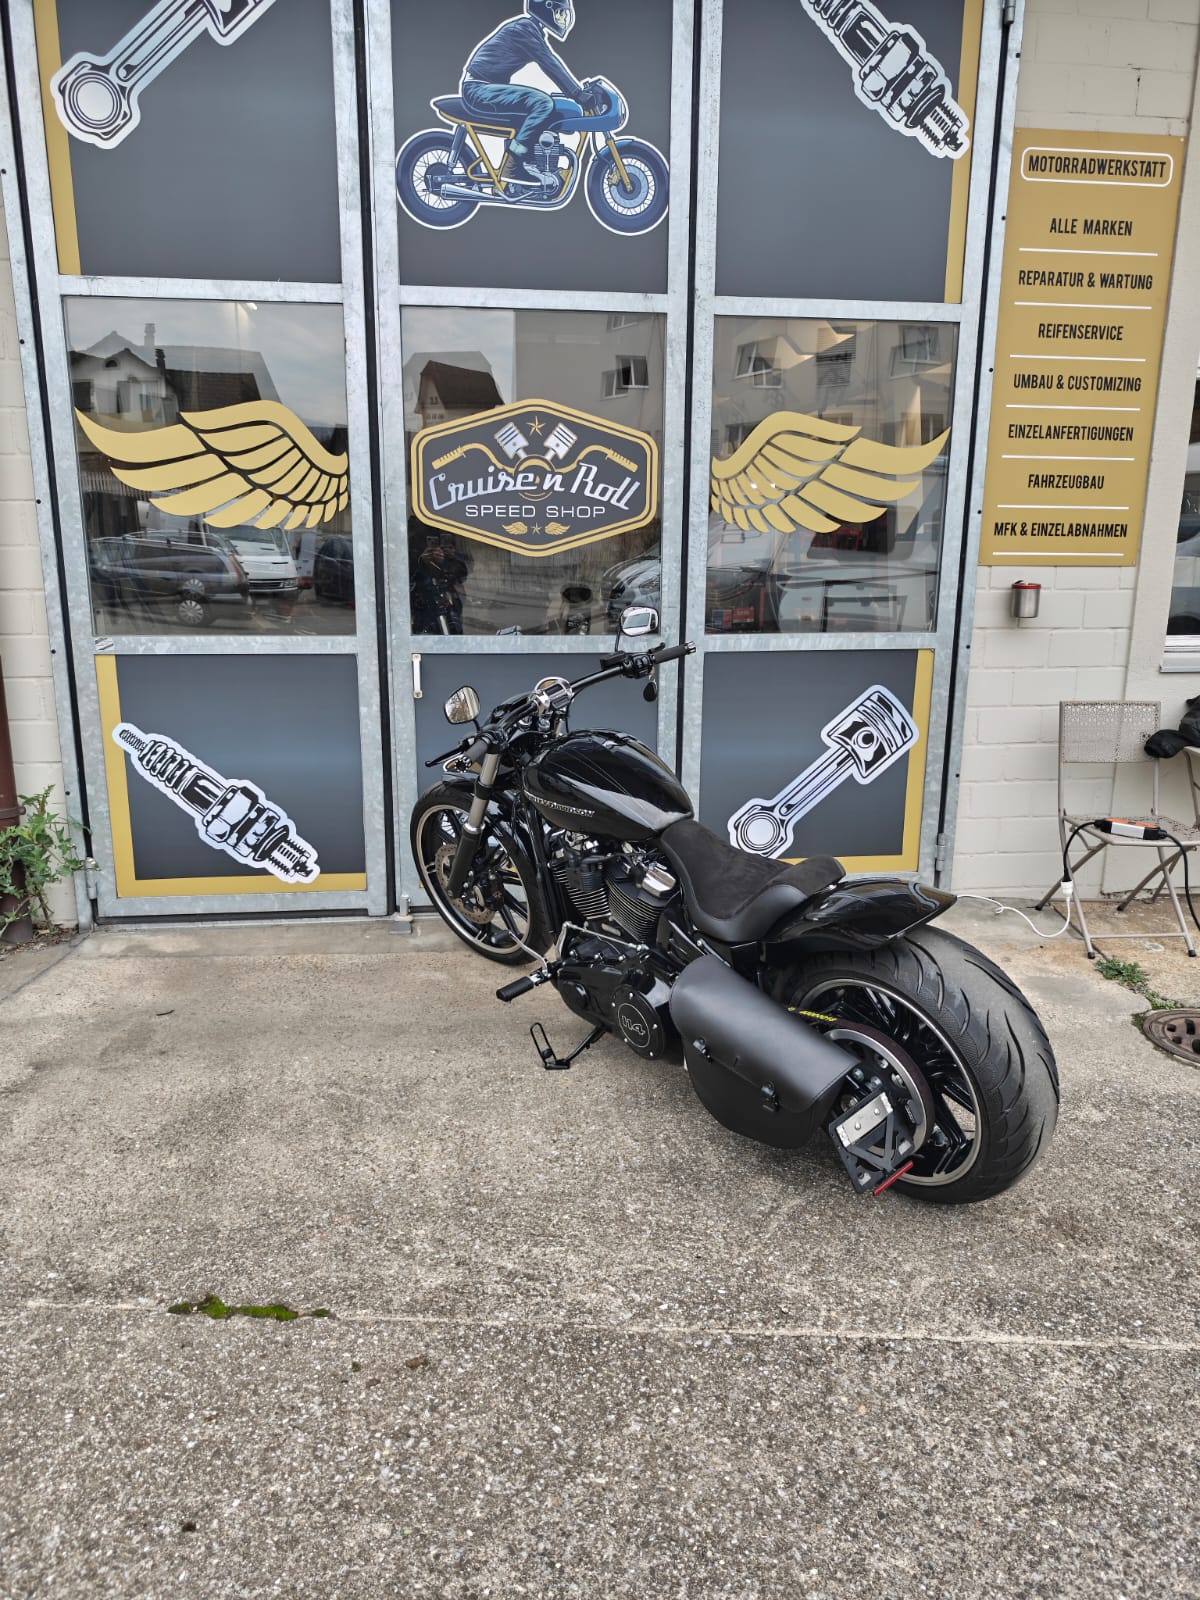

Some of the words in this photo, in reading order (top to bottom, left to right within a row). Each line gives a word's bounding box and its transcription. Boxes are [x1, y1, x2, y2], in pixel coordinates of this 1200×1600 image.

[1028, 155, 1167, 178] MOTORRADWERKSTATT
[1050, 218, 1078, 234] ALLE
[1083, 219, 1133, 236] MARKEN
[1018, 270, 1085, 288] REPARATUR
[1087, 272, 1095, 288] &
[1100, 273, 1153, 290] WARTUNG
[1038, 323, 1124, 341] REIFENSERVICE
[1013, 374, 1054, 389] UMBAU
[1056, 375, 1064, 390] &
[1067, 376, 1142, 392] CUSTOMIZING
[1008, 424, 1134, 441] EINZELANFERTIGUNGEN
[429, 465, 538, 511] Cruise
[542, 467, 565, 491] n
[570, 462, 641, 511] Roll
[1028, 474, 1105, 490] FAHRZEUGBAU
[465, 504, 536, 518] SPEED
[546, 505, 606, 518] SHOP
[993, 522, 1017, 537] MFK
[1020, 522, 1028, 537] &
[1030, 523, 1128, 538] EINZELABNAHMEN
